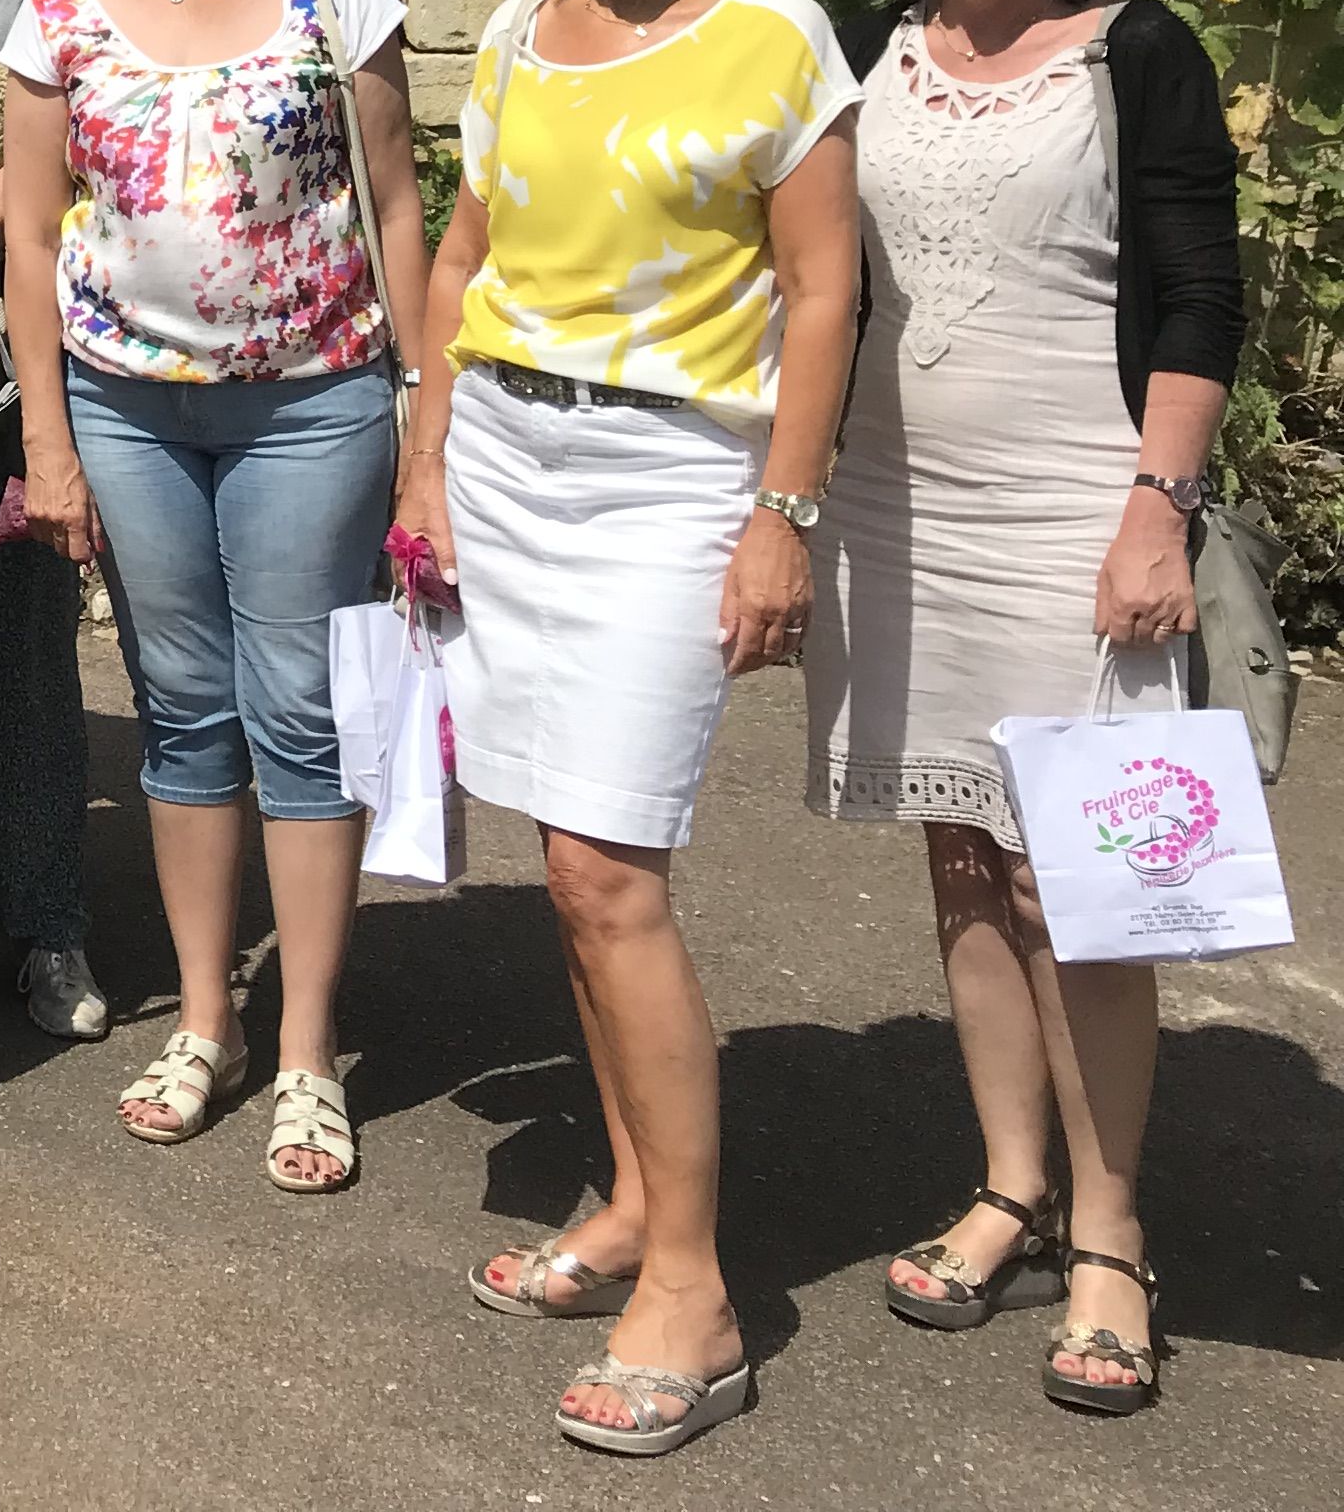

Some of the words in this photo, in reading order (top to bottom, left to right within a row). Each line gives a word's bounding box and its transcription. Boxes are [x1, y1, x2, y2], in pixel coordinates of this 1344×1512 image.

[1082, 774, 1174, 819] Fruirouge
[1109, 809, 1125, 828] &
[1128, 799, 1160, 821] Cie
